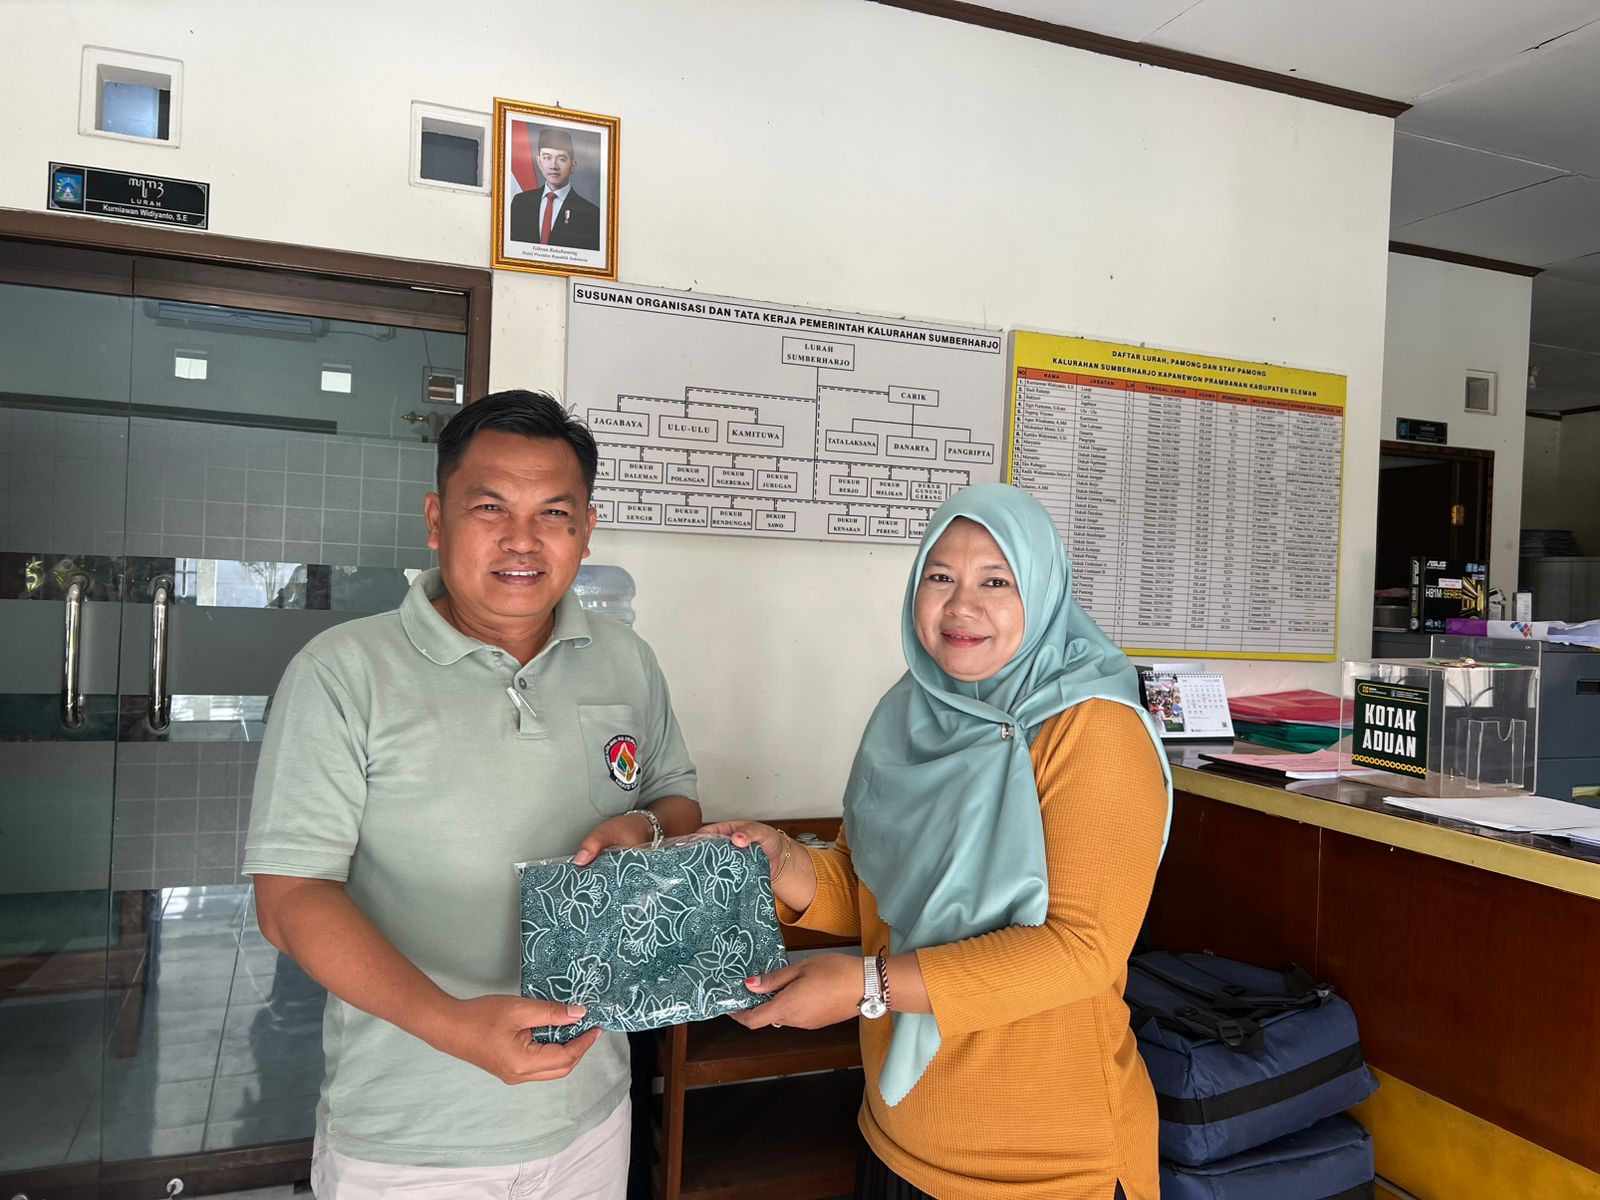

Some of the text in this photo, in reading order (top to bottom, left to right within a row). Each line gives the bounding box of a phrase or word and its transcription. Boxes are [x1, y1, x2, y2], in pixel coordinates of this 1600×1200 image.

[131, 198, 162, 207] LURAH
[102, 204, 188, 222] Kurniawan Widiyanto, S.E
[576, 289, 999, 350] SUSUNAN ORGANISASI DAN TATA KERJA PEMERINTAH KALURAHAN SUMBERHARJO
[804, 344, 834, 352] LURAH
[787, 354, 850, 366] SUMBERHARJO
[1112, 350, 1140, 360] DAFTAR
[1142, 354, 1169, 365] LURAH,
[1171, 359, 1201, 368] PAMONG
[1238, 368, 1266, 377] PAMONG
[1052, 358, 1317, 397] KALURAHAN SUMBERHARJO KAPANEWON PRAMBANAN KABUPATEN SLEMAN
[900, 392, 926, 400] CARIK
[594, 418, 642, 428] JAGABAYA
[668, 424, 710, 434] ULU-ULU
[732, 429, 780, 440] KAMITUWA
[845, 439, 876, 448] LAKSANA
[894, 443, 930, 452] DANARTA
[948, 448, 991, 457] PANGRIPTA
[677, 466, 699, 474] DUKUH
[624, 472, 658, 480] DALEMAN
[1365, 703, 1416, 731] KOTAK
[1362, 728, 1416, 758] ADUAN
